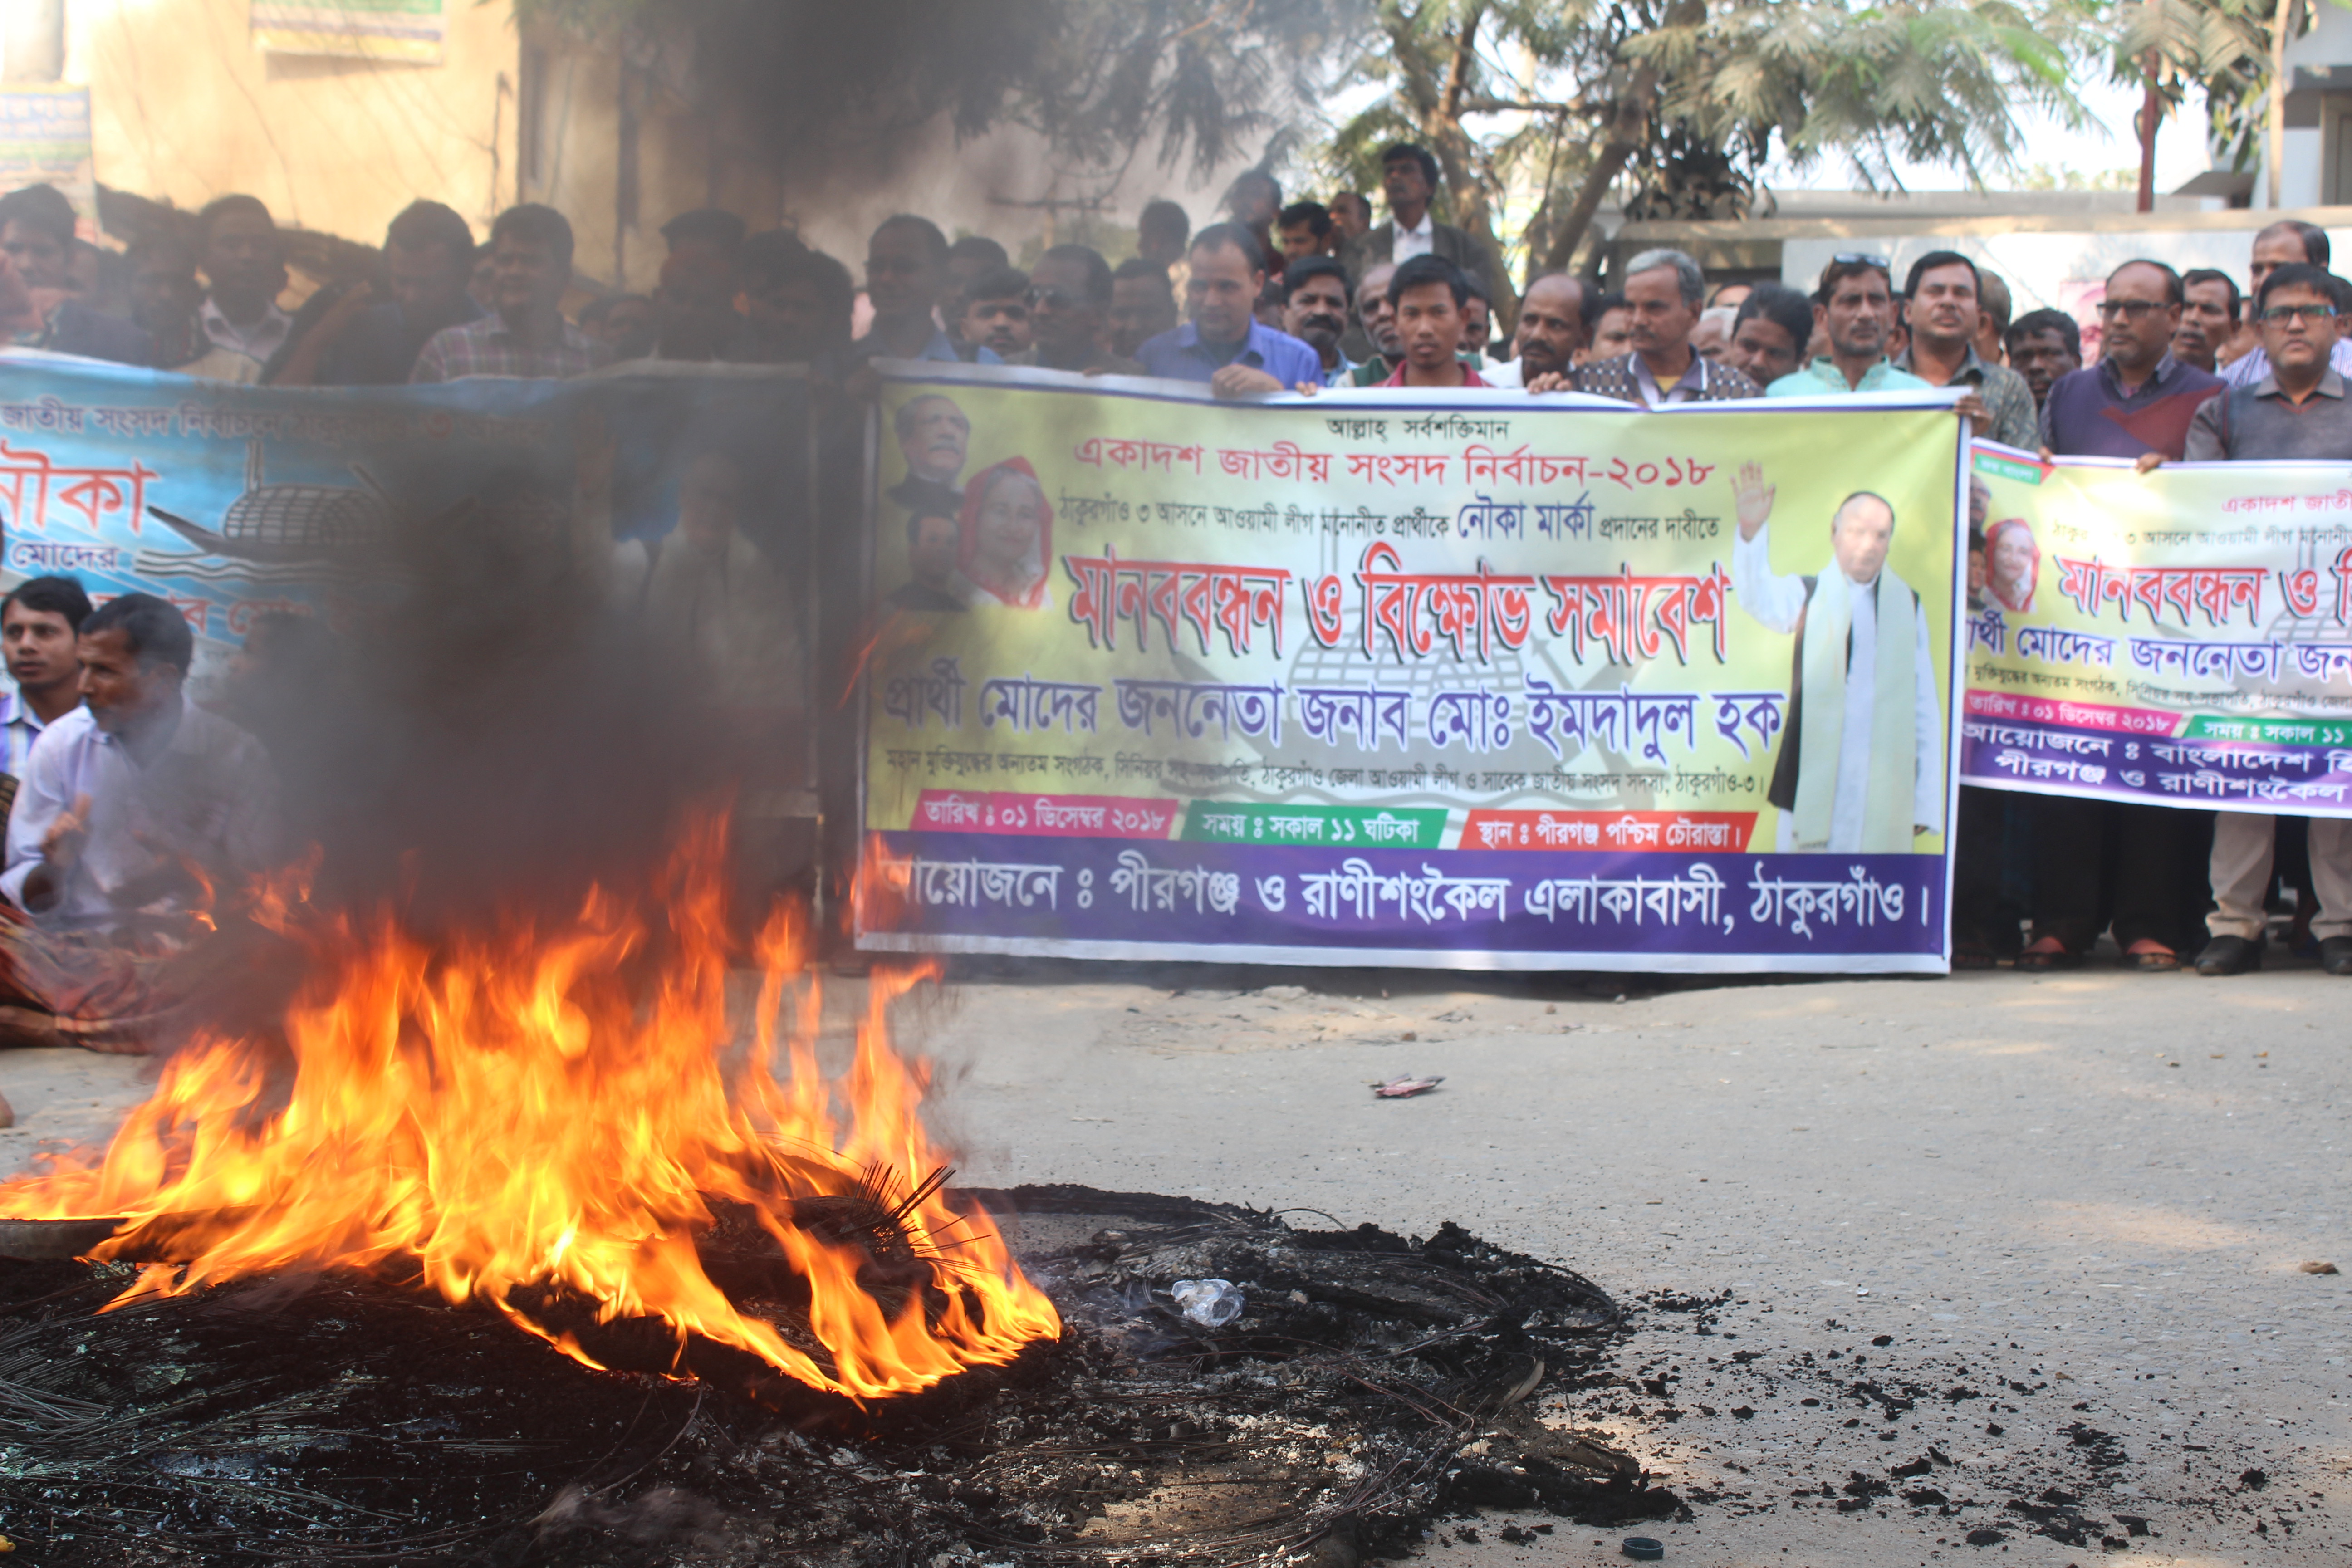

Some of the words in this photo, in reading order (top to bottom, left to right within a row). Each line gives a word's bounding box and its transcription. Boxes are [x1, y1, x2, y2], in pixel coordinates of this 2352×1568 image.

[1, 396, 85, 433] জাতীয়
[94, 407, 171, 438] সংসদ
[1403, 412, 1511, 440] সর্বশক্তিমান
[1075, 437, 1205, 475] একাদশ
[1216, 441, 1333, 483] জাতীয়
[1346, 453, 1451, 487] সংসদ
[1461, 444, 1716, 491] নির্বাচন-২০১৮
[1136, 504, 1151, 523] ৩
[1156, 501, 1208, 527] আসনে
[1212, 502, 1278, 534] আওয়ামী
[1284, 504, 1314, 535] লীগ
[1321, 505, 1387, 538] মনোনীত
[1391, 506, 1450, 539] প্রার্থীকে
[1457, 490, 1528, 540] নৌকা
[1534, 490, 1596, 541] মার্কা
[1599, 515, 1659, 542] প্রদানের
[1665, 507, 1721, 542] দাবীতে
[2222, 495, 2296, 514] একাদশ
[2143, 526, 2191, 545] আসনে
[2298, 524, 2352, 545] মনোনী
[11, 541, 121, 571] মোদের
[1063, 543, 1293, 660] মানববন্ধন
[1303, 574, 1343, 649] ও
[1353, 540, 1537, 665] বিক্ষোভ
[1540, 560, 1733, 666] সমাবেশ
[2053, 555, 2271, 627] মানববন্ধন
[2279, 569, 2318, 619] ও
[1966, 609, 2008, 654] ার্থী
[2017, 624, 2117, 665] মোদের
[2129, 637, 2285, 683] জননেতা
[979, 671, 1103, 734] মোদের
[1112, 678, 1285, 748] জননেতা
[1295, 683, 1412, 752] জনাব
[1524, 673, 1700, 767] ইমদাদুল
[1710, 691, 1788, 761] হক
[2322, 726, 2344, 743] ১১
[1994, 748, 2107, 786] পীরগঞ্জ
[2120, 769, 2146, 788] ও
[2150, 743, 2315, 773] বাংলাদেশ
[1466, 772, 1476, 789] ও
[1482, 771, 1527, 792] সাবেক
[922, 793, 979, 826] তারিখ
[1002, 805, 1028, 828] ০১
[1034, 798, 1106, 830] ডিসেম্বর
[1112, 808, 1165, 833] ২০১৮
[1202, 813, 1247, 839] সময়
[1269, 814, 1325, 842] সকাল
[1330, 818, 1356, 841] ১১
[1362, 811, 1420, 843] ঘটিকা
[1476, 820, 1513, 851] স্থান
[1535, 814, 1599, 847] পীরগঞ্জ
[1606, 815, 1659, 848] পশ্চিম
[1109, 849, 1241, 916] পীরগঞ্জ
[1255, 876, 1286, 912] ও
[1298, 858, 1512, 924] রাণীশংকৈল
[1524, 863, 1734, 935] এলাকাবাসী,
